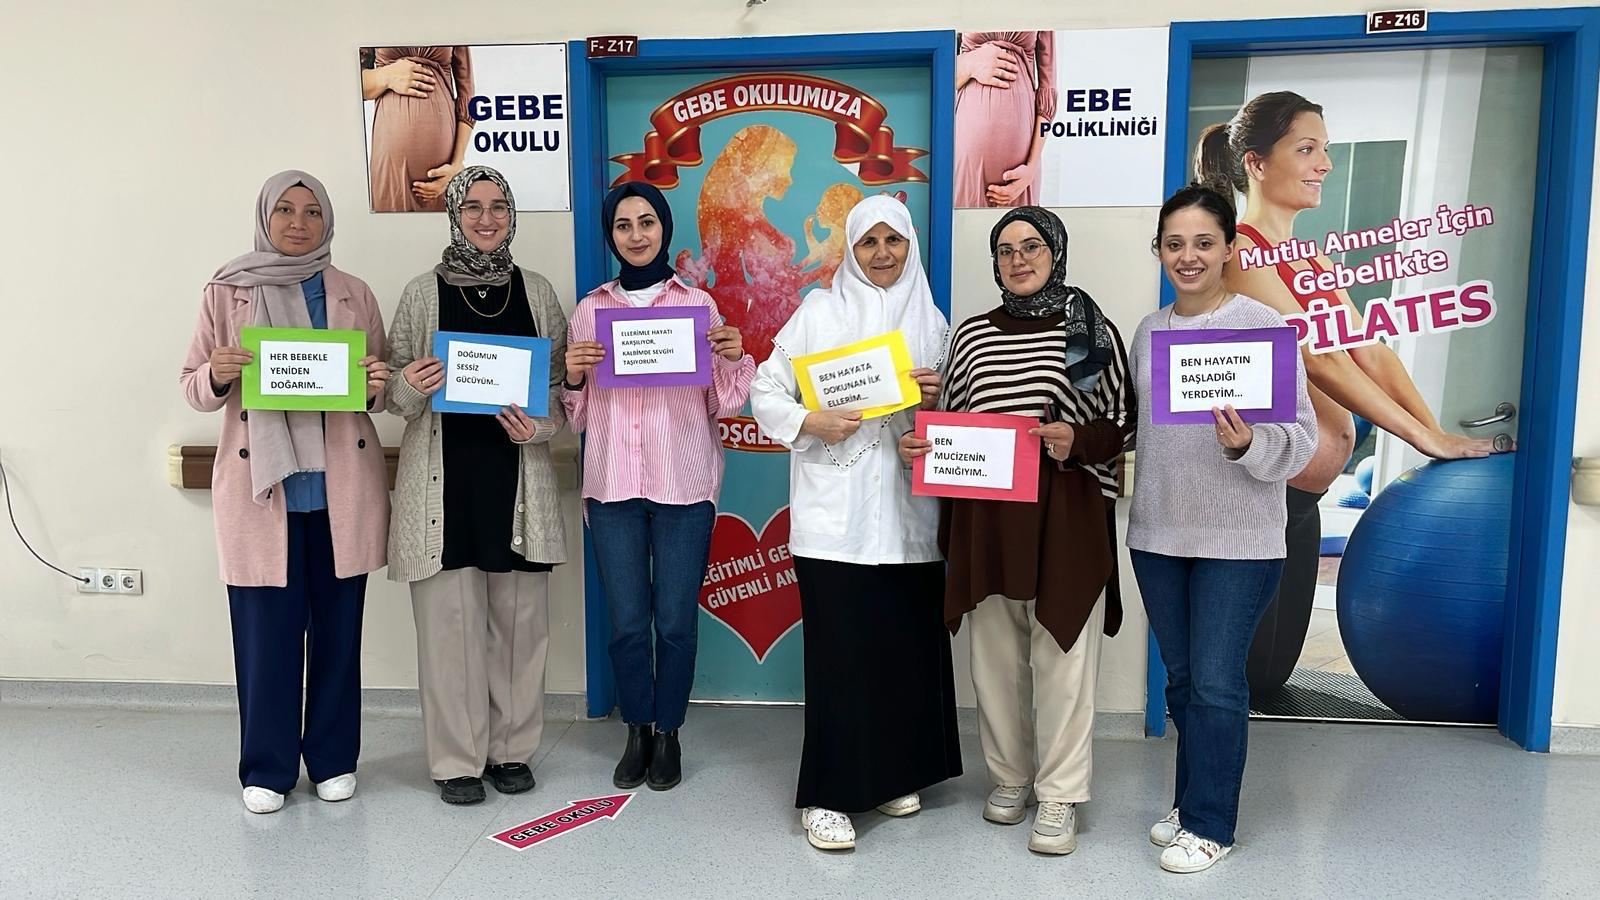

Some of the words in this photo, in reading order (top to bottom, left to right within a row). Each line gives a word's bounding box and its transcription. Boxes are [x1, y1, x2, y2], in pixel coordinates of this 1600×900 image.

[1374, 15, 1383, 28] F
[1394, 13, 1420, 27] Z16
[607, 39, 634, 52] Z17
[673, 89, 728, 122] GEBE
[733, 83, 862, 120] OKULUMUZA
[1066, 88, 1132, 112] EBE
[467, 94, 564, 121] GEBE
[1040, 116, 1157, 138] POLİKLİNİĞİ
[474, 130, 560, 153] OKULU
[1239, 239, 1317, 271] Mutlu
[1323, 217, 1432, 255] Anneler
[1436, 204, 1494, 236] İçin
[1292, 248, 1449, 296] Gebelikte
[620, 329, 650, 337] ELLERİMLE
[270, 353, 288, 361] HER
[290, 353, 328, 361] BEBEKLE
[457, 350, 498, 360] DOĞUMUN
[652, 347, 674, 355] SEVGİYİ
[456, 363, 480, 371] SESSİZ
[1180, 358, 1202, 367] BEN
[1204, 355, 1251, 366] HAYATIN
[270, 366, 310, 375] YENİDEN
[819, 371, 836, 383] BEN
[838, 362, 873, 378] HAYATA
[1181, 370, 1236, 384] BAŞLADIĞI
[823, 379, 867, 395] DOKUNAN
[867, 374, 882, 385] İLK
[1182, 387, 1243, 399] YERDEYİM...
[934, 437, 953, 446] BEN
[934, 451, 986, 462] MUCİZENİN
[707, 572, 773, 609] GÜVENLİ
[510, 821, 559, 841] GEBE
[556, 800, 614, 823] OKULU
